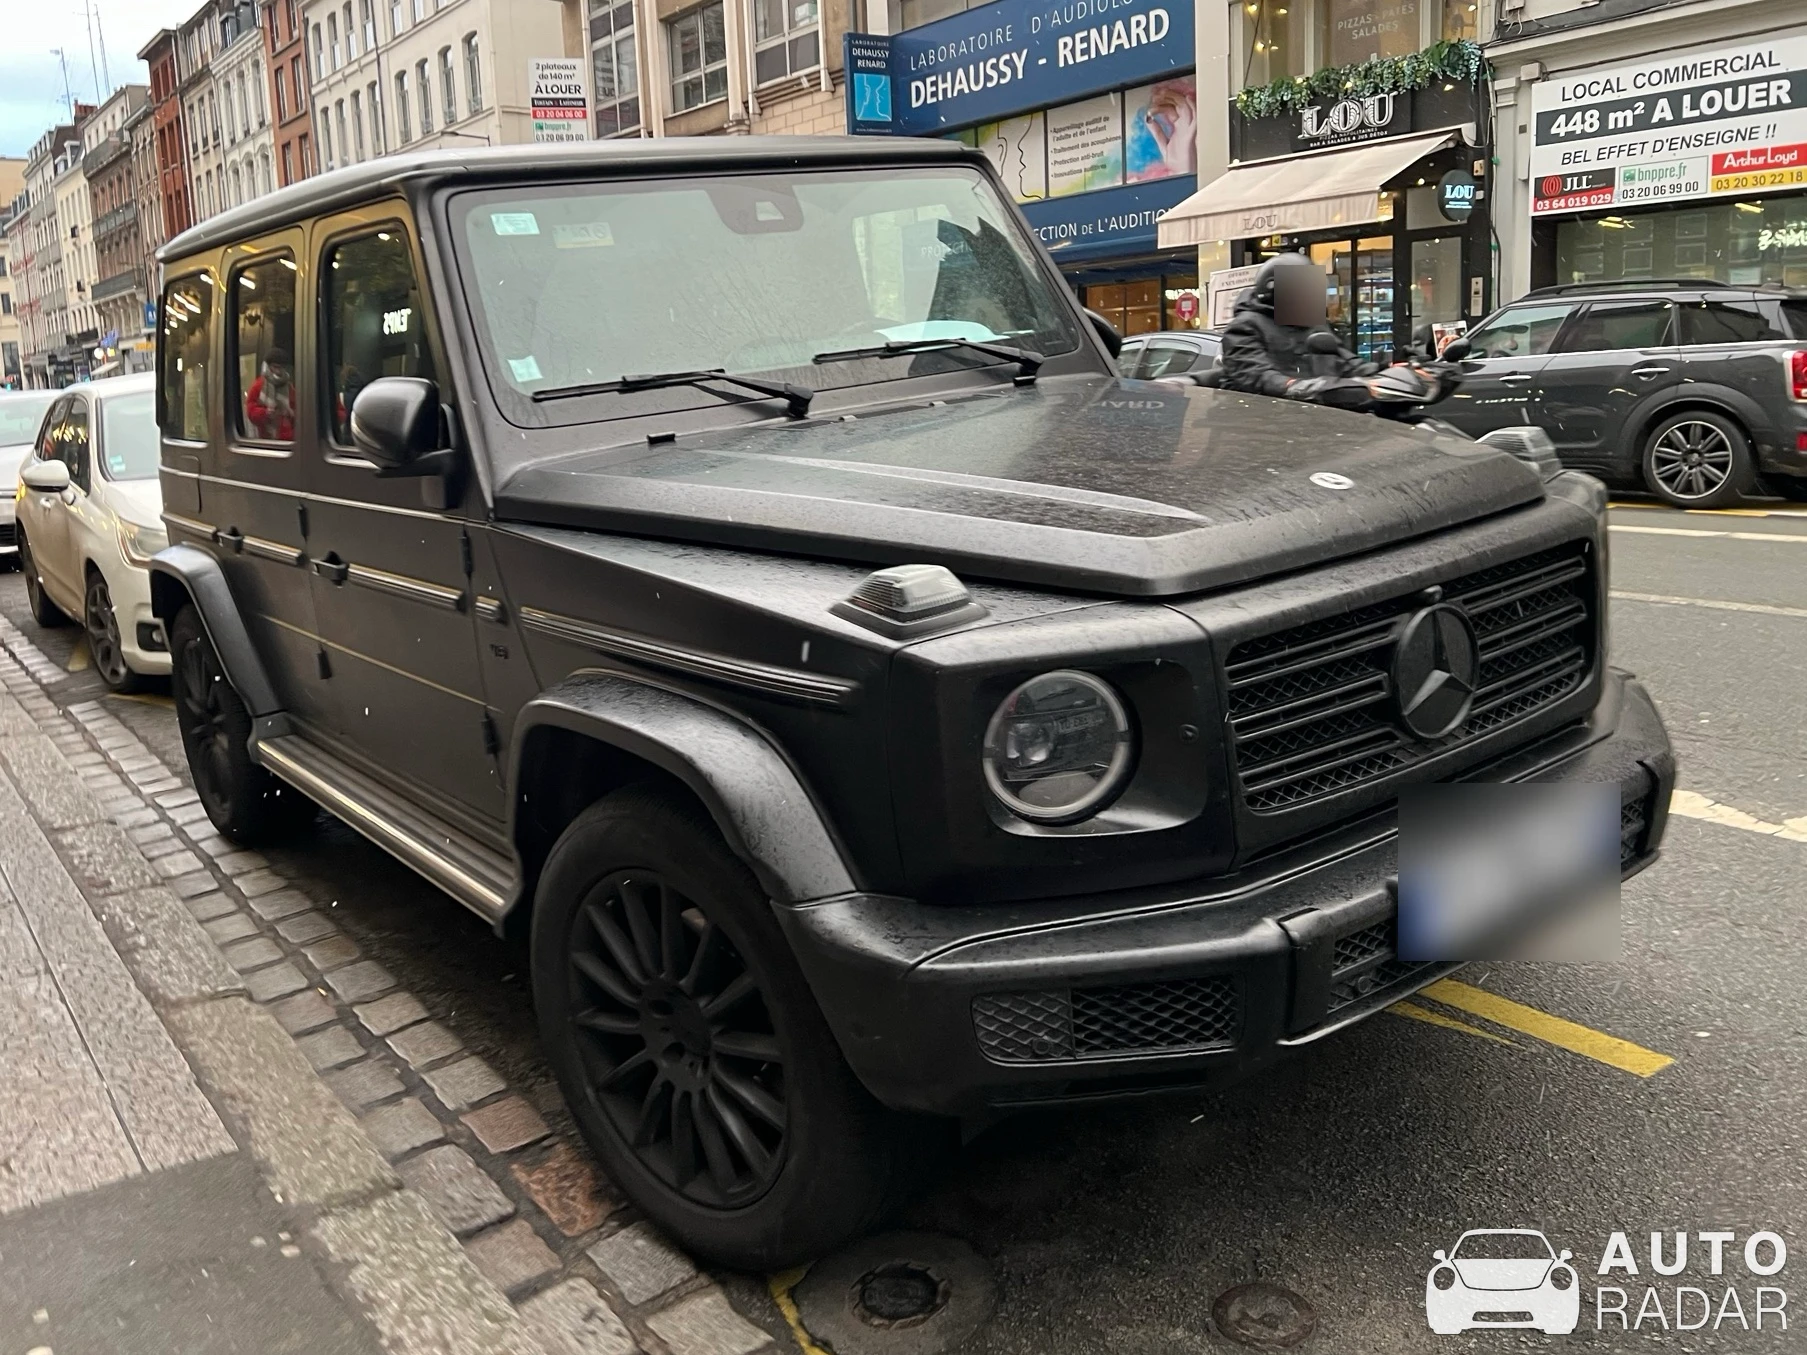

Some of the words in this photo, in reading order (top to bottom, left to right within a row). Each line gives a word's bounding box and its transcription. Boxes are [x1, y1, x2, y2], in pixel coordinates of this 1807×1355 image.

[1338, 13, 1372, 30] PIZZAS
[1351, 21, 1398, 40] SALADES
[851, 39, 890, 47] LABORATOIRE
[910, 25, 1013, 71] LABORATOIRE
[852, 47, 890, 59] DEHAUSSY
[911, 48, 1029, 108] DEHAUSSY
[1037, 57, 1047, 66] -
[1058, 8, 1170, 68] RENARD
[535, 62, 540, 70] 2
[541, 62, 577, 73] plateaux
[857, 59, 886, 69] RENARD
[538, 72, 549, 80] de
[550, 72, 563, 80] 140
[1561, 76, 1627, 102] LOCAL
[1633, 50, 1781, 90] COMMERCIAL
[535, 80, 543, 94] À
[545, 84, 582, 94] LOUER
[536, 110, 545, 118] 03
[546, 110, 554, 118] 20
[574, 110, 583, 118] 00
[1298, 91, 1398, 139] LOU
[1550, 108, 1600, 137] 448
[1608, 101, 1645, 130] m²
[1650, 98, 1674, 124] A
[1682, 79, 1792, 120] LOUER
[1087, 125, 1107, 135] l'enfant
[1328, 136, 1351, 144] SALADES
[1561, 150, 1592, 165] BEL
[1596, 140, 1649, 161] EFFET
[1652, 126, 1761, 154] D'ENSEIGNE
[1765, 124, 1777, 139] !!
[1723, 147, 1767, 169] Arthur
[1767, 146, 1797, 165] Loyd
[1637, 162, 1687, 183] bnppre.fr
[1716, 179, 1730, 190] 03
[1733, 177, 1748, 188] 20
[1752, 175, 1766, 186] 30
[1770, 172, 1784, 184] 22
[1789, 171, 1803, 182] 18
[1445, 184, 1475, 199] LOU
[1563, 175, 1592, 192] JLL
[1622, 188, 1635, 199] 03
[1637, 186, 1650, 197] 20
[1653, 184, 1666, 195] 06
[1669, 182, 1682, 194] 99
[1685, 181, 1699, 192] 00
[1536, 200, 1550, 211] 03
[1552, 198, 1566, 209] 64
[1568, 196, 1588, 207] 019
[1081, 223, 1093, 236] DE
[1243, 215, 1277, 231] LOU
